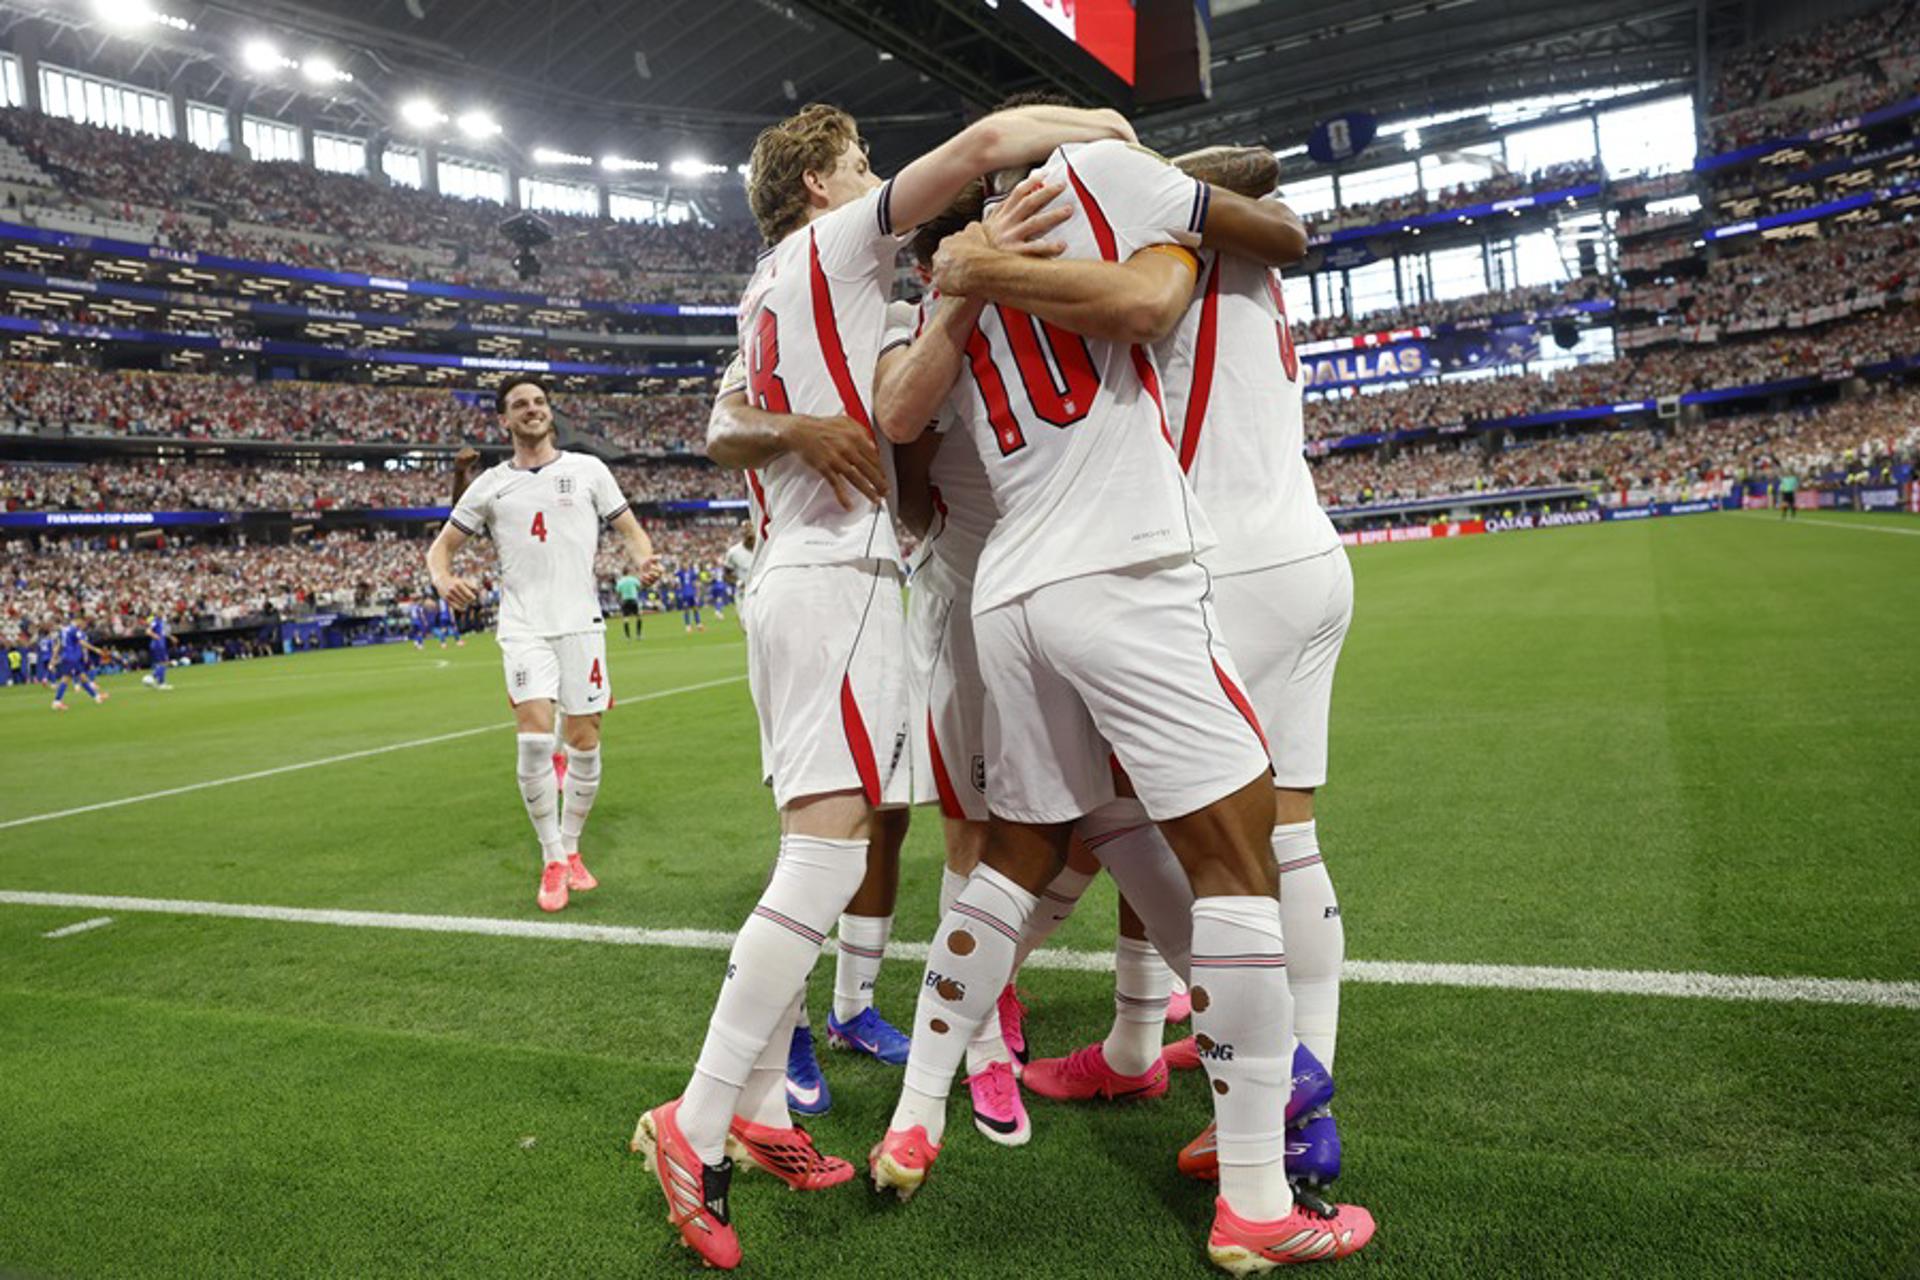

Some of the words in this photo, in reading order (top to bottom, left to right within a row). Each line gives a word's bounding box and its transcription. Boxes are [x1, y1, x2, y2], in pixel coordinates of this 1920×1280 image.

[964, 301, 1102, 458] 10
[1302, 347, 1422, 386] DALLAS
[47, 514, 68, 524] FIFA
[70, 514, 102, 524] WORLD
[531, 511, 547, 542] 4
[1485, 516, 1534, 533] QATAR
[1539, 509, 1600, 528] AIRWAYS
[590, 657, 603, 689] 4
[1198, 1043, 1235, 1061] NG
